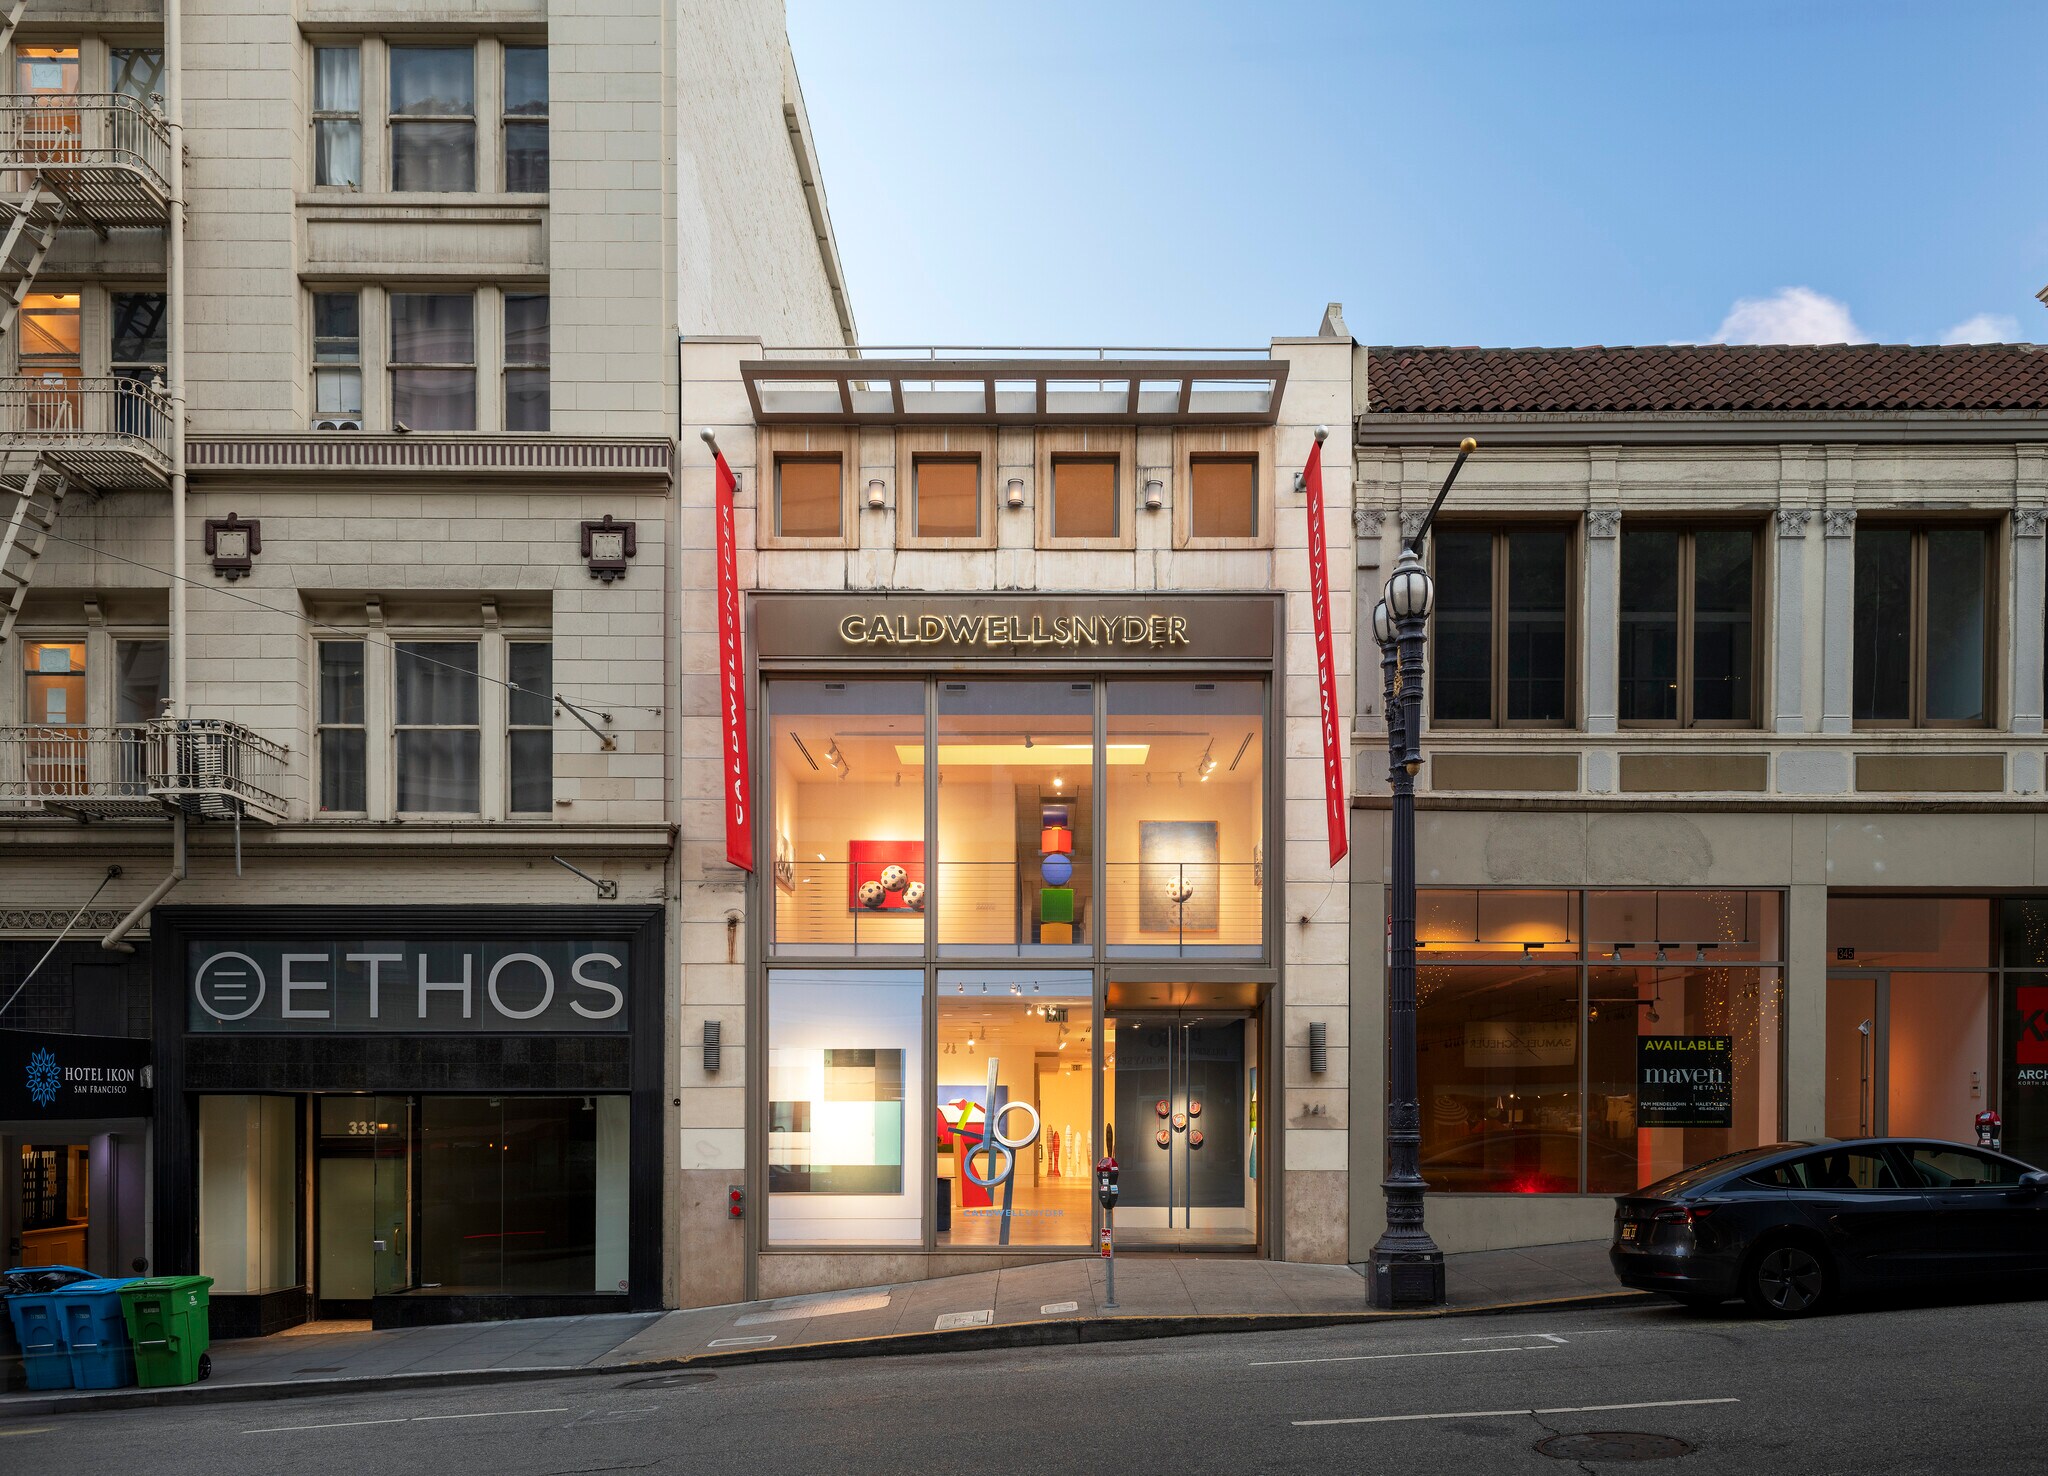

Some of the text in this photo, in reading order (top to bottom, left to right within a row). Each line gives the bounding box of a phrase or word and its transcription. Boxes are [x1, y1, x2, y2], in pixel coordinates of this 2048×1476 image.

[840, 616, 1190, 643] CALDWELLSNYDER
[723, 504, 744, 826] CALDWELLSNYDER
[1838, 948, 1854, 959] 345
[281, 952, 624, 1019] ETHOS
[1645, 1040, 1725, 1051] AVAILABLE
[65, 1067, 135, 1082] HOTEL IKON
[1644, 1068, 1725, 1084] maven
[74, 1085, 127, 1094] SAN FRANCISCO
[349, 1121, 377, 1135] 333
